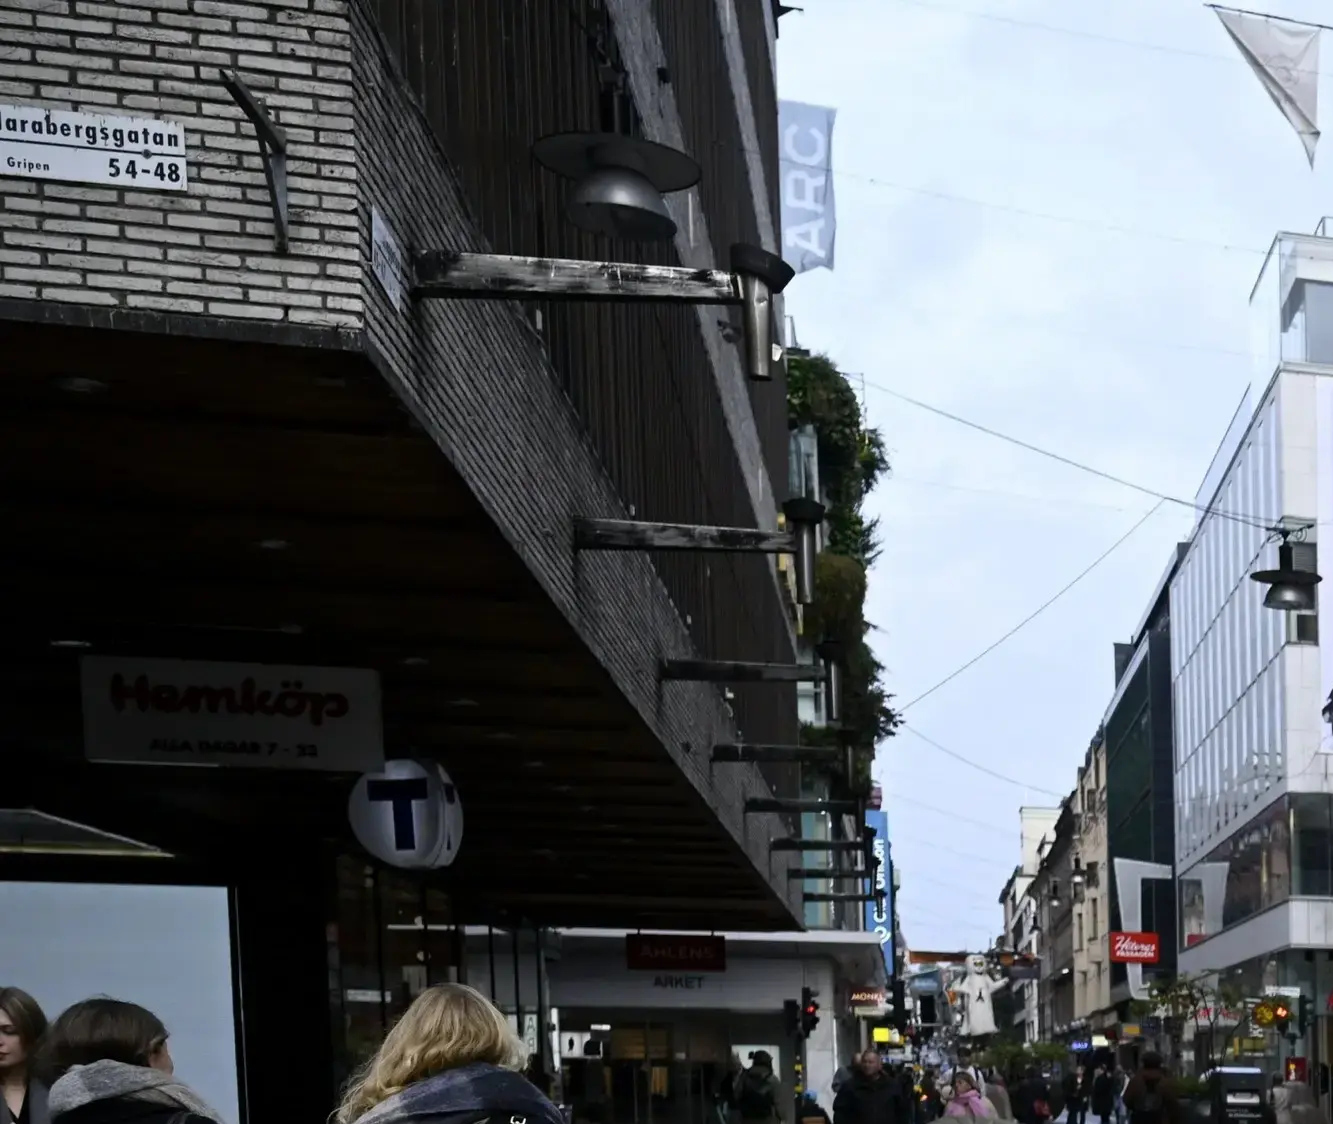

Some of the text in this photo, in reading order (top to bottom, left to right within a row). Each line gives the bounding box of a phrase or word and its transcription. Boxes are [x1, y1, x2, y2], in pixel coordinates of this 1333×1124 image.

[7, 156, 181, 182] Gripen 54-48
[784, 123, 827, 259] ARC
[111, 672, 350, 726] Hemköp
[367, 778, 427, 850] T
[653, 976, 704, 989] ARKET
